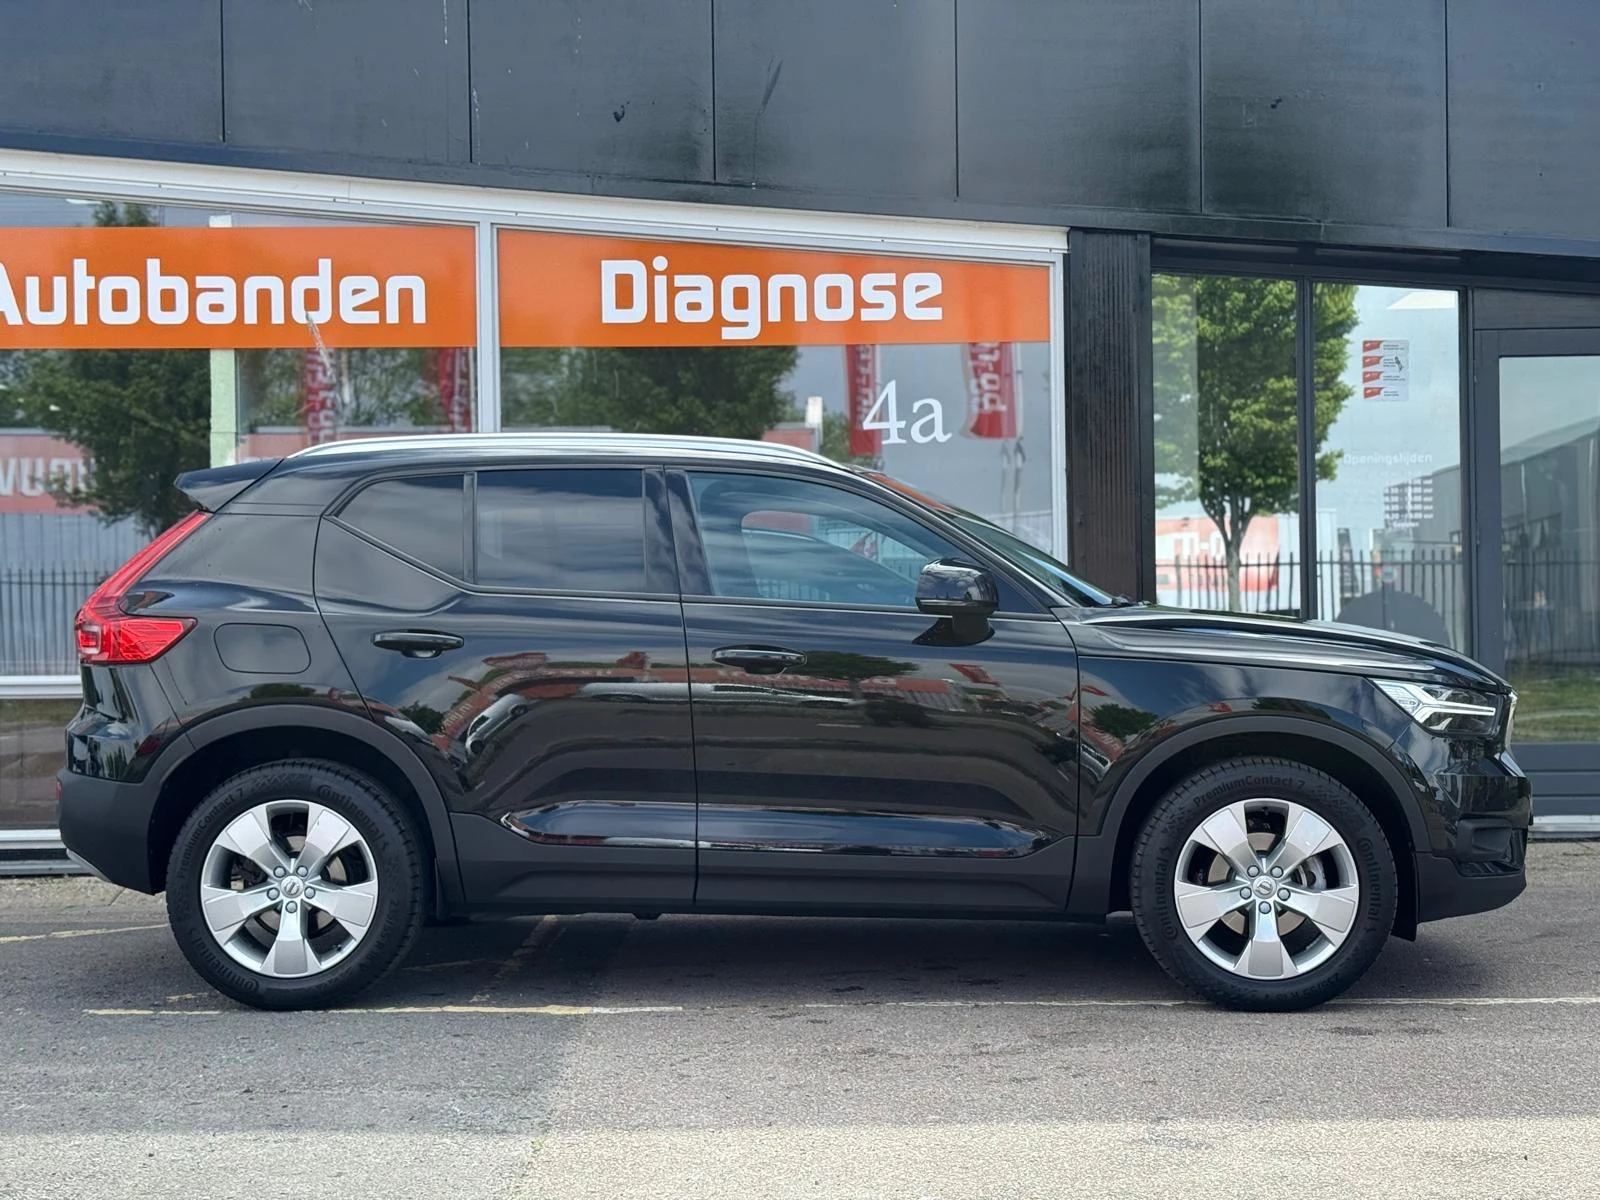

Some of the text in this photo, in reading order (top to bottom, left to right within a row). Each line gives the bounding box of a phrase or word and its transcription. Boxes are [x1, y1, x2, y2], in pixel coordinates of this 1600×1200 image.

[600, 255, 943, 340] Diagnose
[861, 379, 952, 445] 4a
[318, 784, 385, 841] Continental
[1193, 774, 1292, 808] PremiumContact
[178, 792, 235, 877] PremiumContact
[1154, 856, 1178, 941] Continental
[1355, 836, 1382, 922] Continental
[191, 936, 260, 994] Continental
